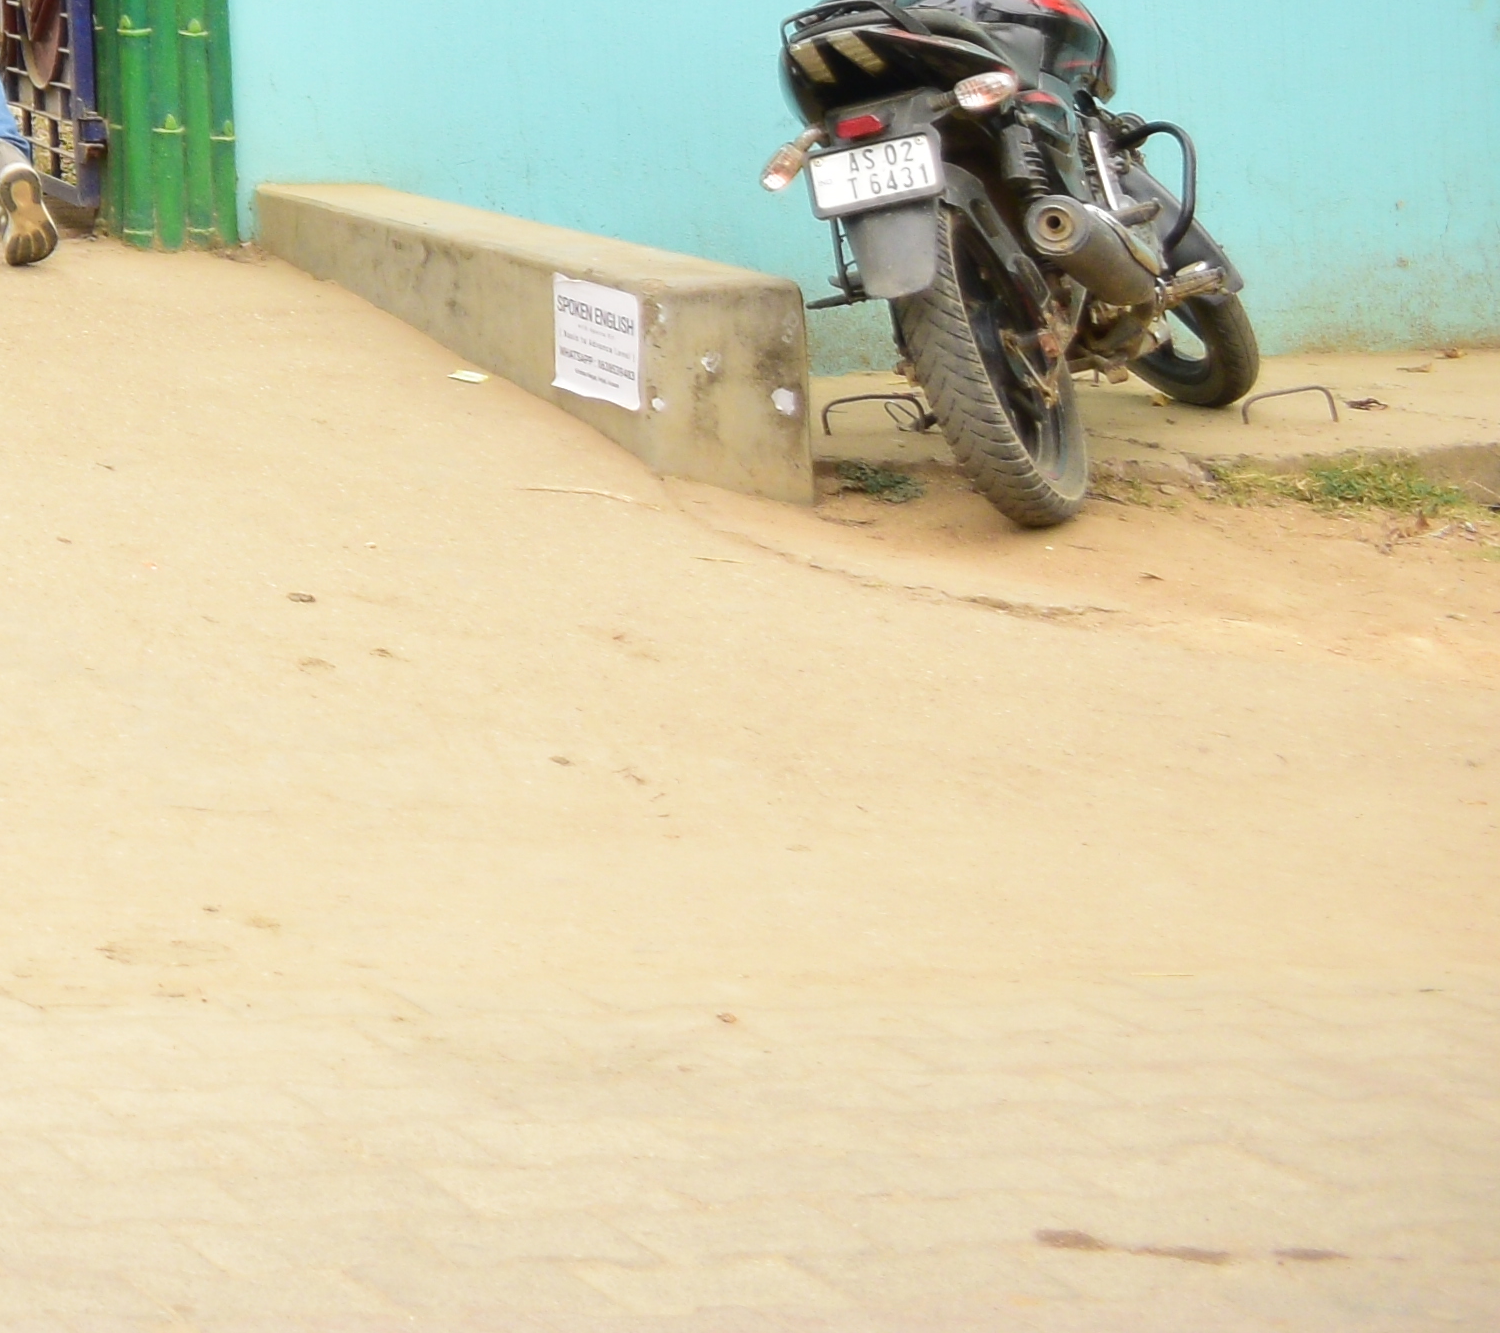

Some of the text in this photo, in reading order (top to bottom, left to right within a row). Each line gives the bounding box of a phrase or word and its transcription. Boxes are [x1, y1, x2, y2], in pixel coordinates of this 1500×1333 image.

[849, 141, 914, 173] AS 02
[557, 295, 593, 322] SPOKEN
[594, 308, 634, 336] ENGLISH
